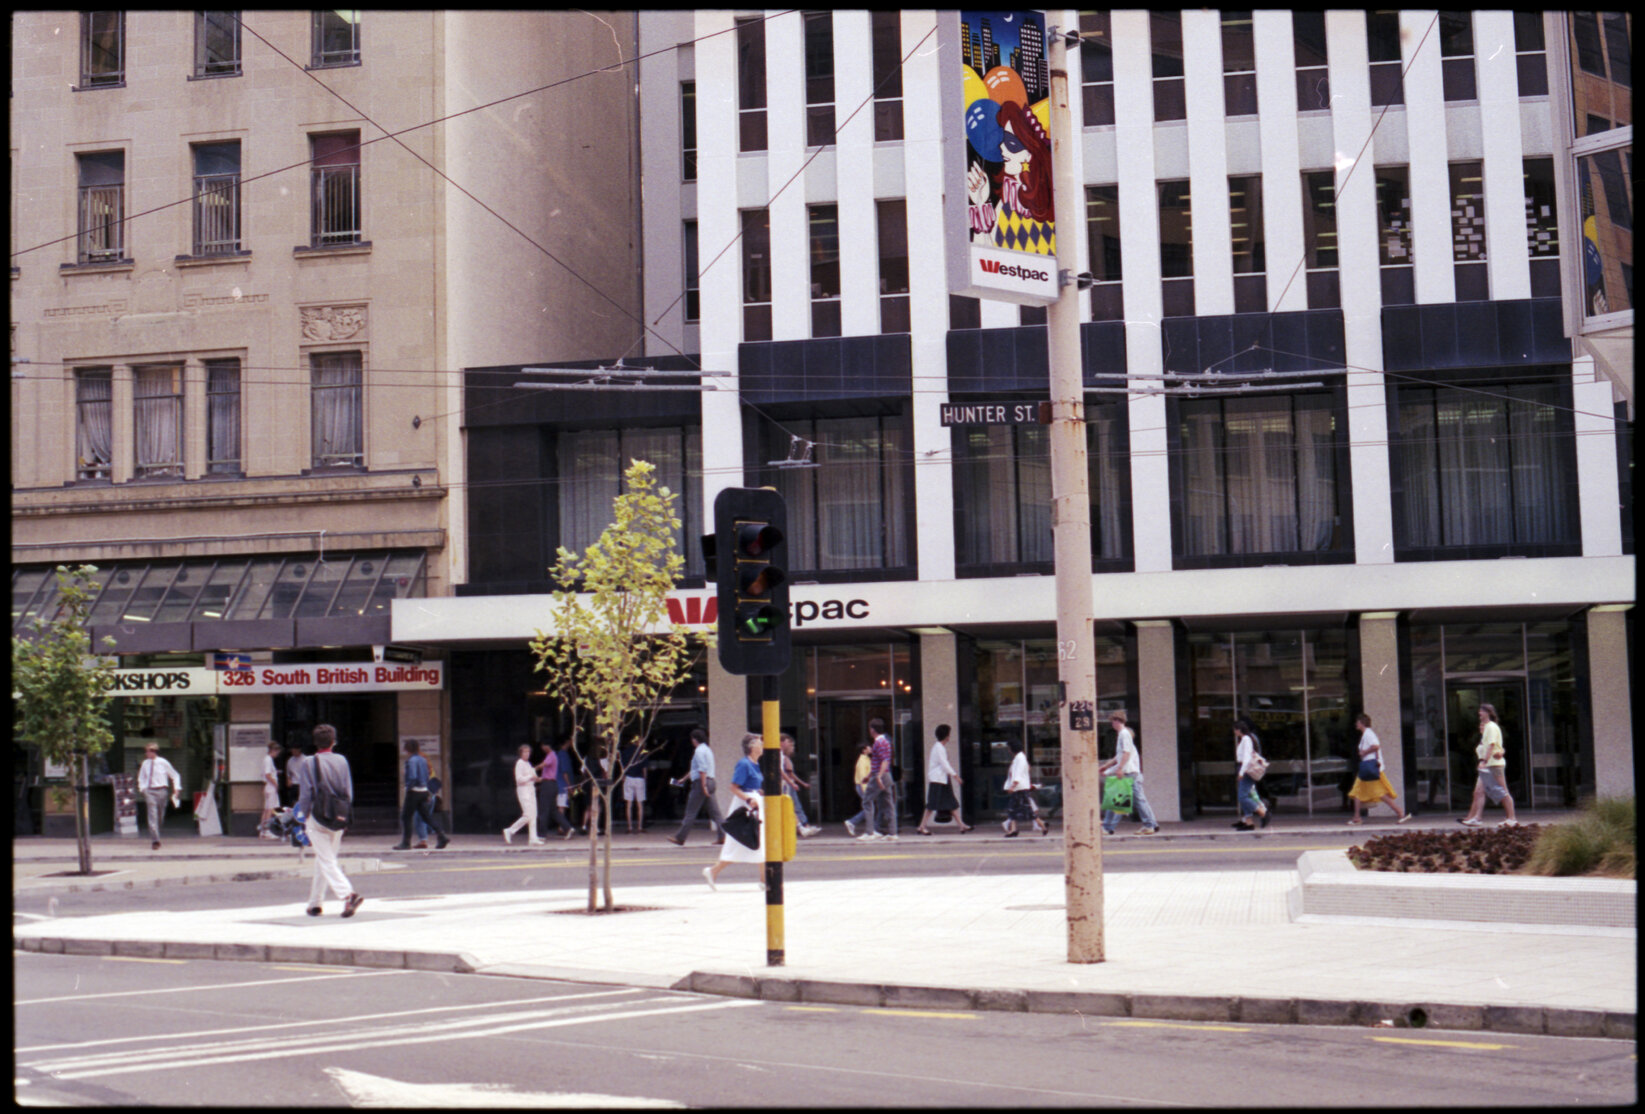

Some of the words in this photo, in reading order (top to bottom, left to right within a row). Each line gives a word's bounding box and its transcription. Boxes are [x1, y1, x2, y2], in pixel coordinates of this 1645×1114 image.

[979, 259, 1049, 281] Westpac
[944, 406, 1006, 423] HUNTER
[1014, 405, 1035, 422] ST.
[665, 596, 870, 626] Wpac
[97, 672, 190, 691] OKSHOPS
[223, 669, 255, 686] 326
[262, 669, 310, 685] South
[317, 668, 368, 684] British
[375, 666, 439, 685] Building
